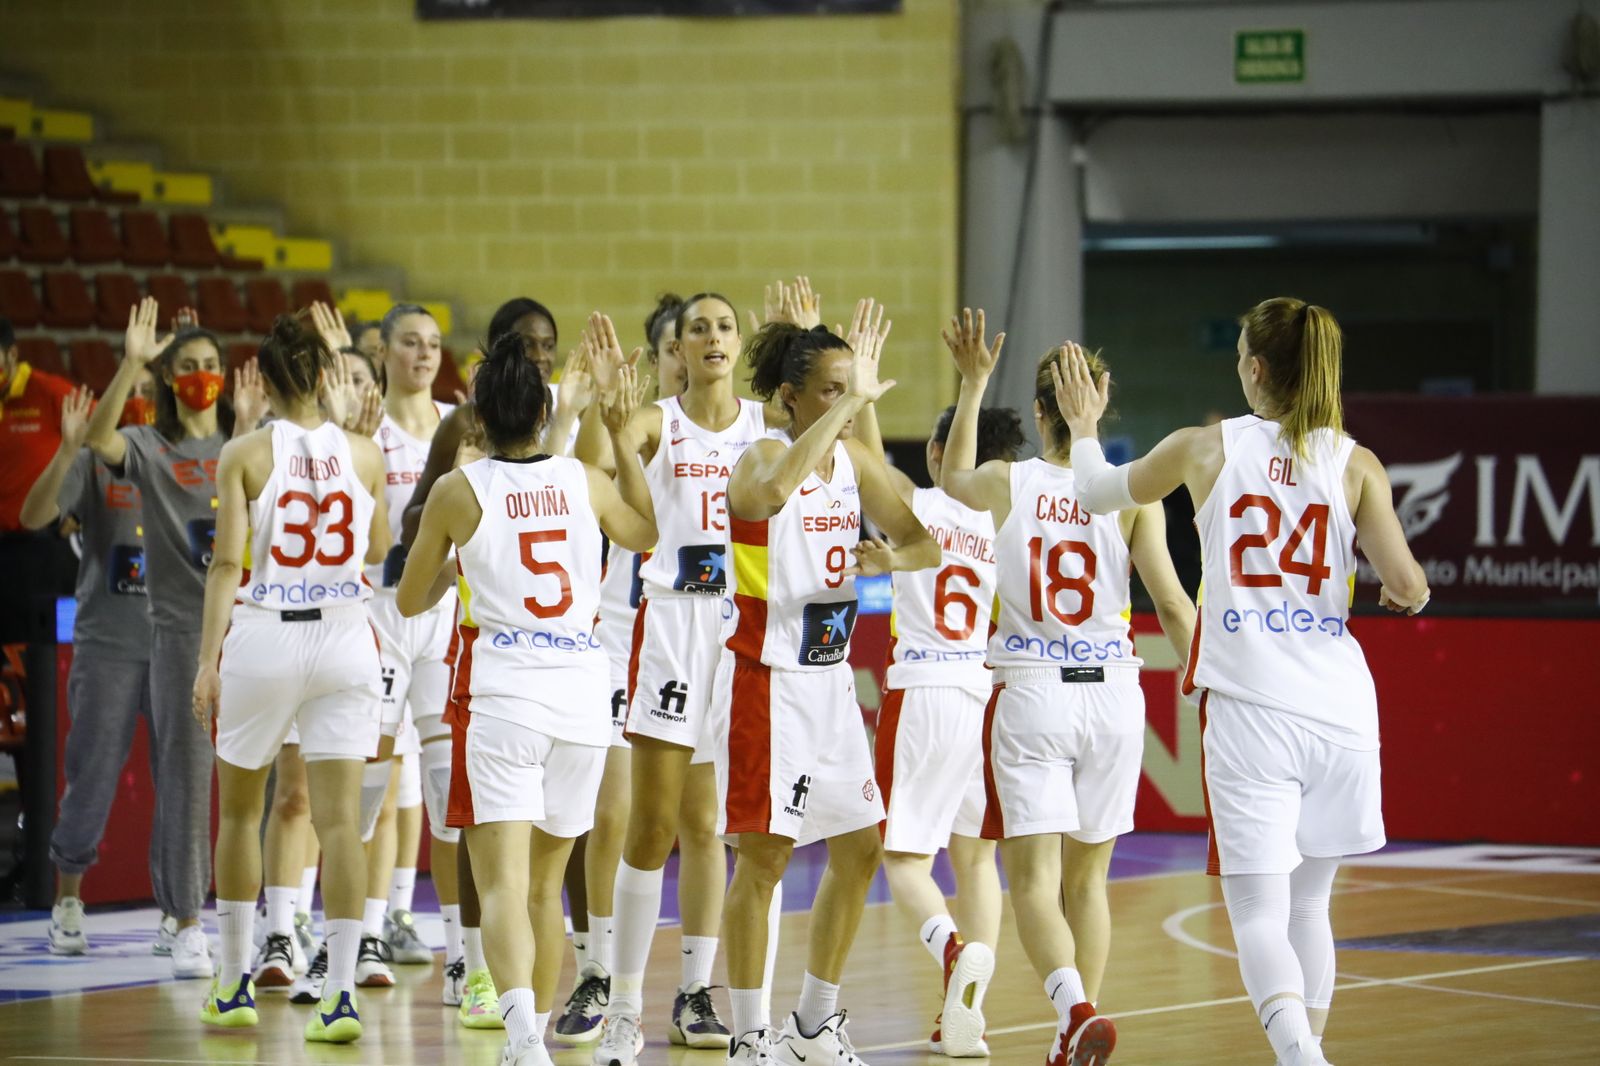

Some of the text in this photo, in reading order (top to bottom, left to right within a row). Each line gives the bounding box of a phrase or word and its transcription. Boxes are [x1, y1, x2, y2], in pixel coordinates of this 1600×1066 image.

[674, 463, 735, 478] ESPA
[1268, 456, 1297, 487] GIL
[505, 485, 570, 519] OUVIÑA
[1036, 494, 1091, 526] CASAS
[271, 490, 354, 568] 33
[803, 511, 860, 532] ESPAÑA
[1229, 494, 1331, 596] 24
[518, 529, 574, 619] 5
[825, 546, 847, 589] 9
[1027, 536, 1097, 626] 18
[252, 578, 360, 604] endesa
[934, 563, 980, 641] 6
[1005, 634, 1123, 662] endesa
[659, 680, 688, 714] fi
[650, 709, 687, 724] network
[792, 774, 811, 810] fi
